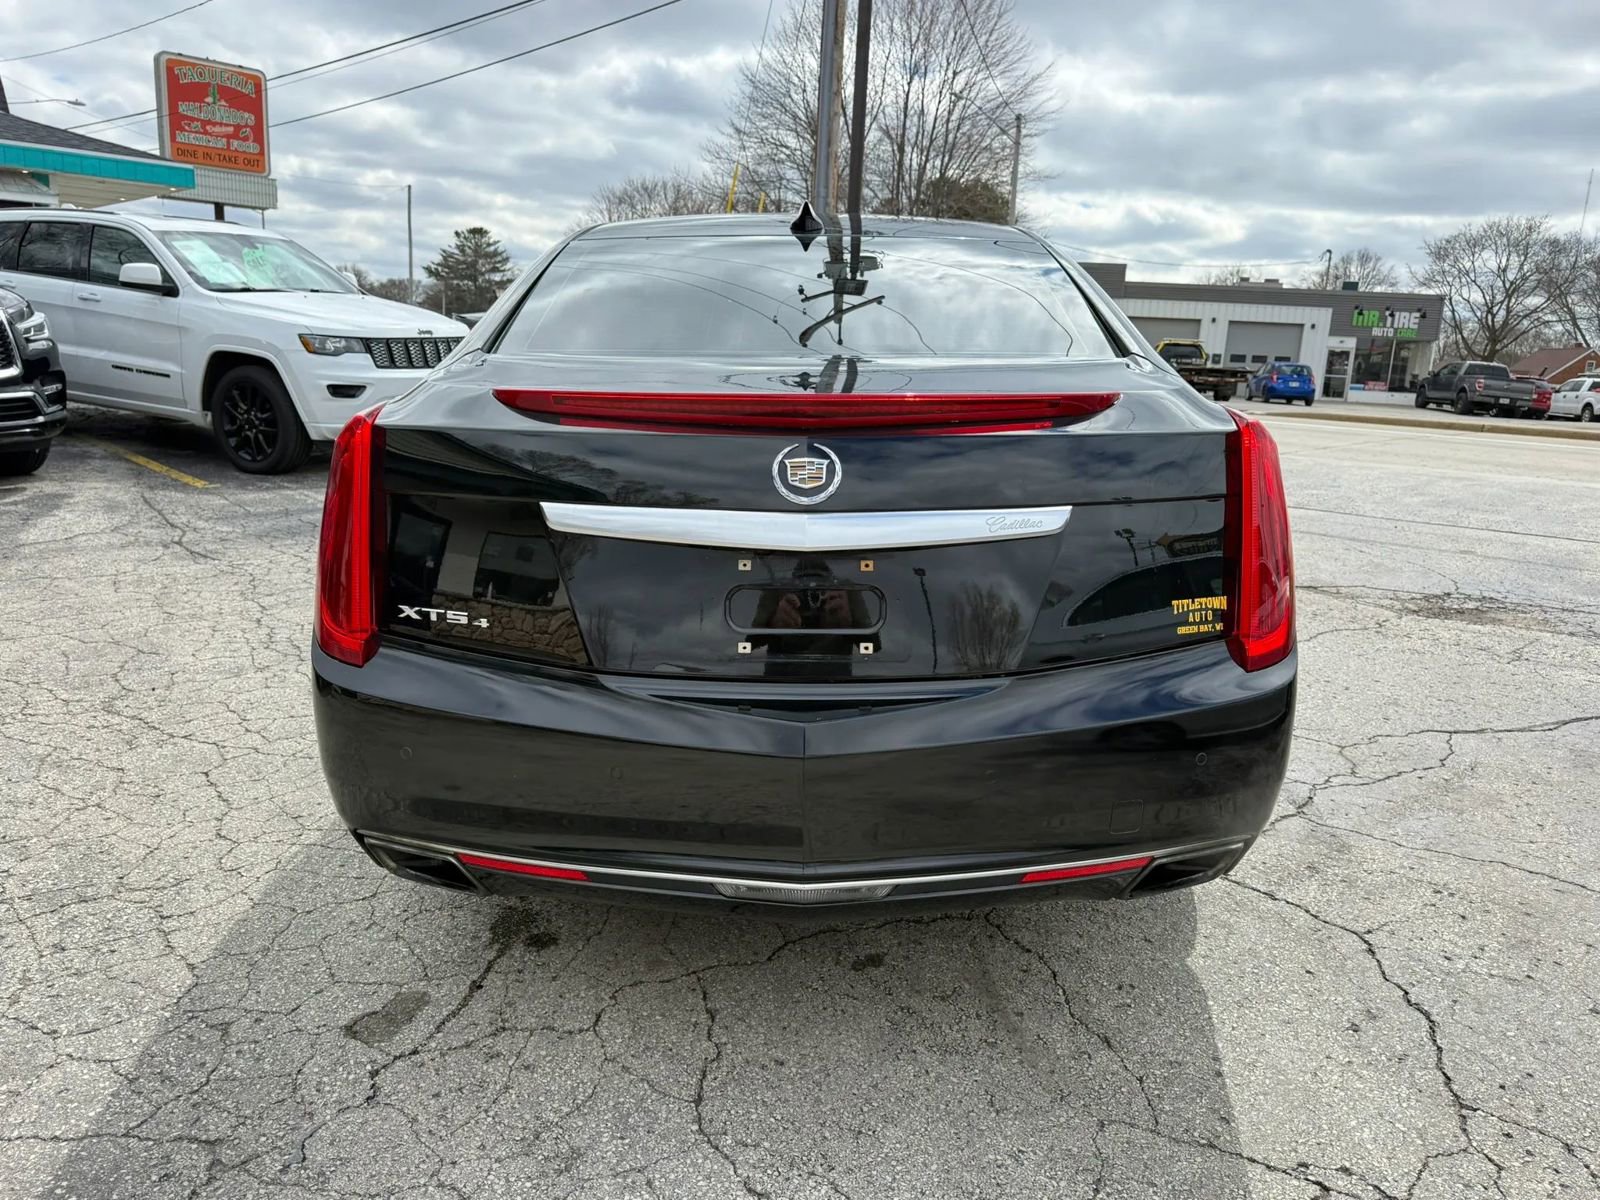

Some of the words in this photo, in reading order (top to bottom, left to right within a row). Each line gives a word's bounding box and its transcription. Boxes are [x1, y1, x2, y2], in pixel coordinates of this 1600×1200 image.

[174, 65, 256, 97] TAQUERIA
[178, 101, 256, 126] MALDONADO'S
[175, 130, 227, 149] MEXICAN
[230, 139, 260, 153] FOOD
[176, 147, 199, 159] DINE
[242, 157, 261, 168] OUT
[1385, 310, 1421, 329] TIRE
[1372, 327, 1394, 337] AUTO
[1397, 328, 1418, 338] CARE
[985, 515, 1044, 533] Cadillac
[1171, 595, 1228, 615] TITLETOWN
[397, 604, 469, 625] XTS
[472, 618, 490, 629] 4
[1188, 610, 1213, 623] AUTO
[1177, 625, 1198, 635] GREEN
[1215, 622, 1224, 631] WI
